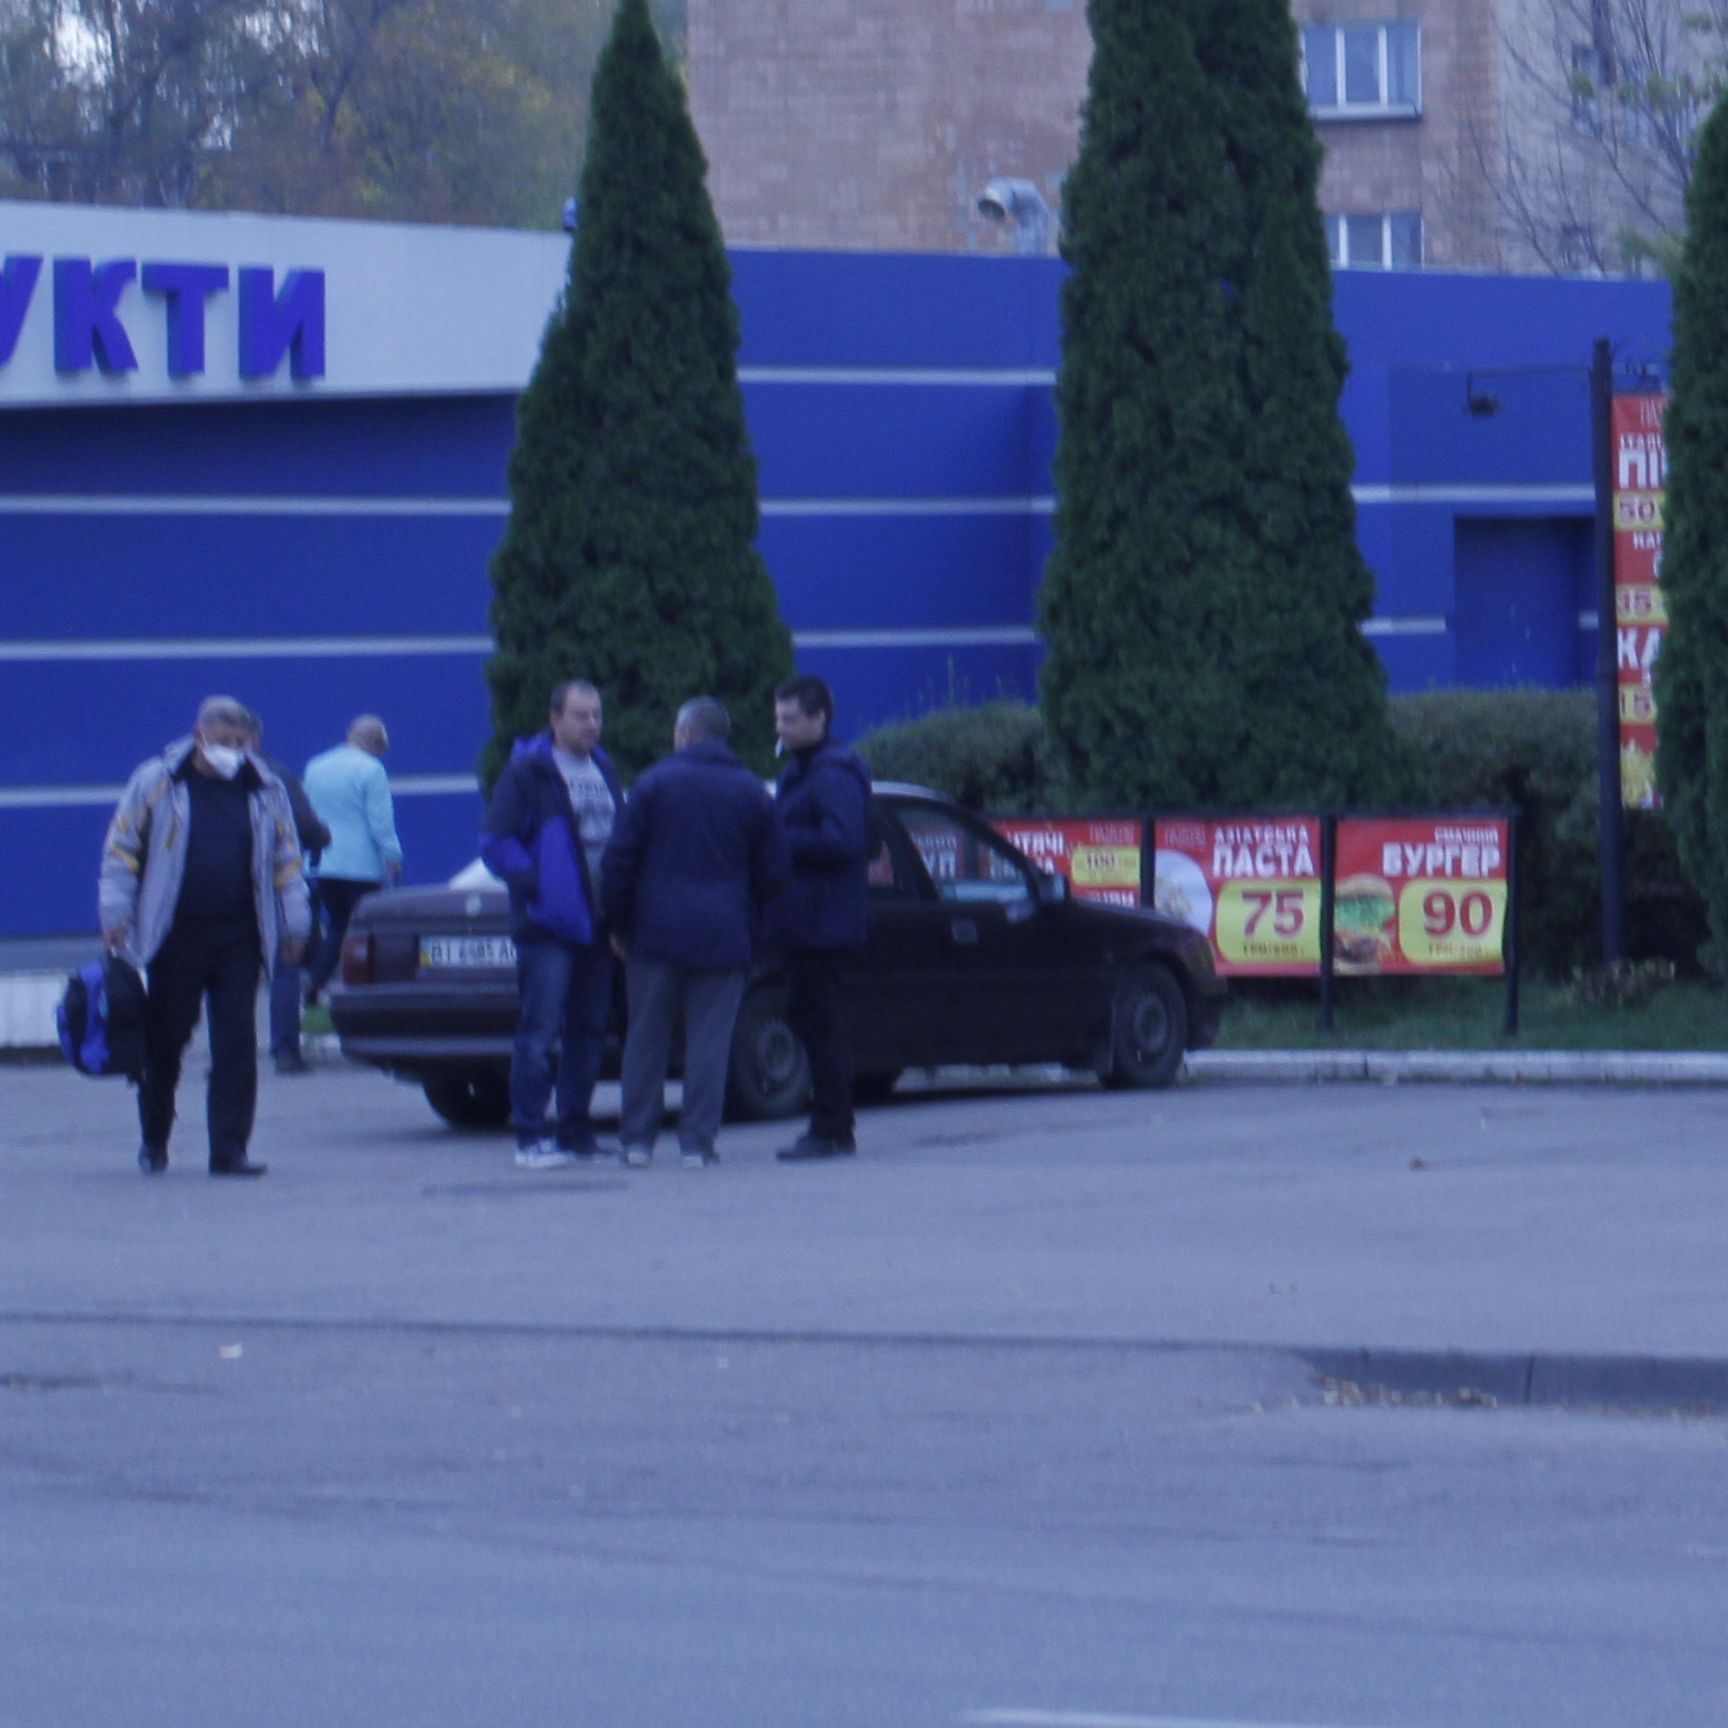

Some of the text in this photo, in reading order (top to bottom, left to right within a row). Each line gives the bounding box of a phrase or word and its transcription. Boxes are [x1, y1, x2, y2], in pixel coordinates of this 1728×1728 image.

[1212, 843, 1315, 878] ПАСТА
[1382, 842, 1500, 878] БУРГЕР
[1242, 889, 1304, 937] 75
[1423, 889, 1493, 938] 90
